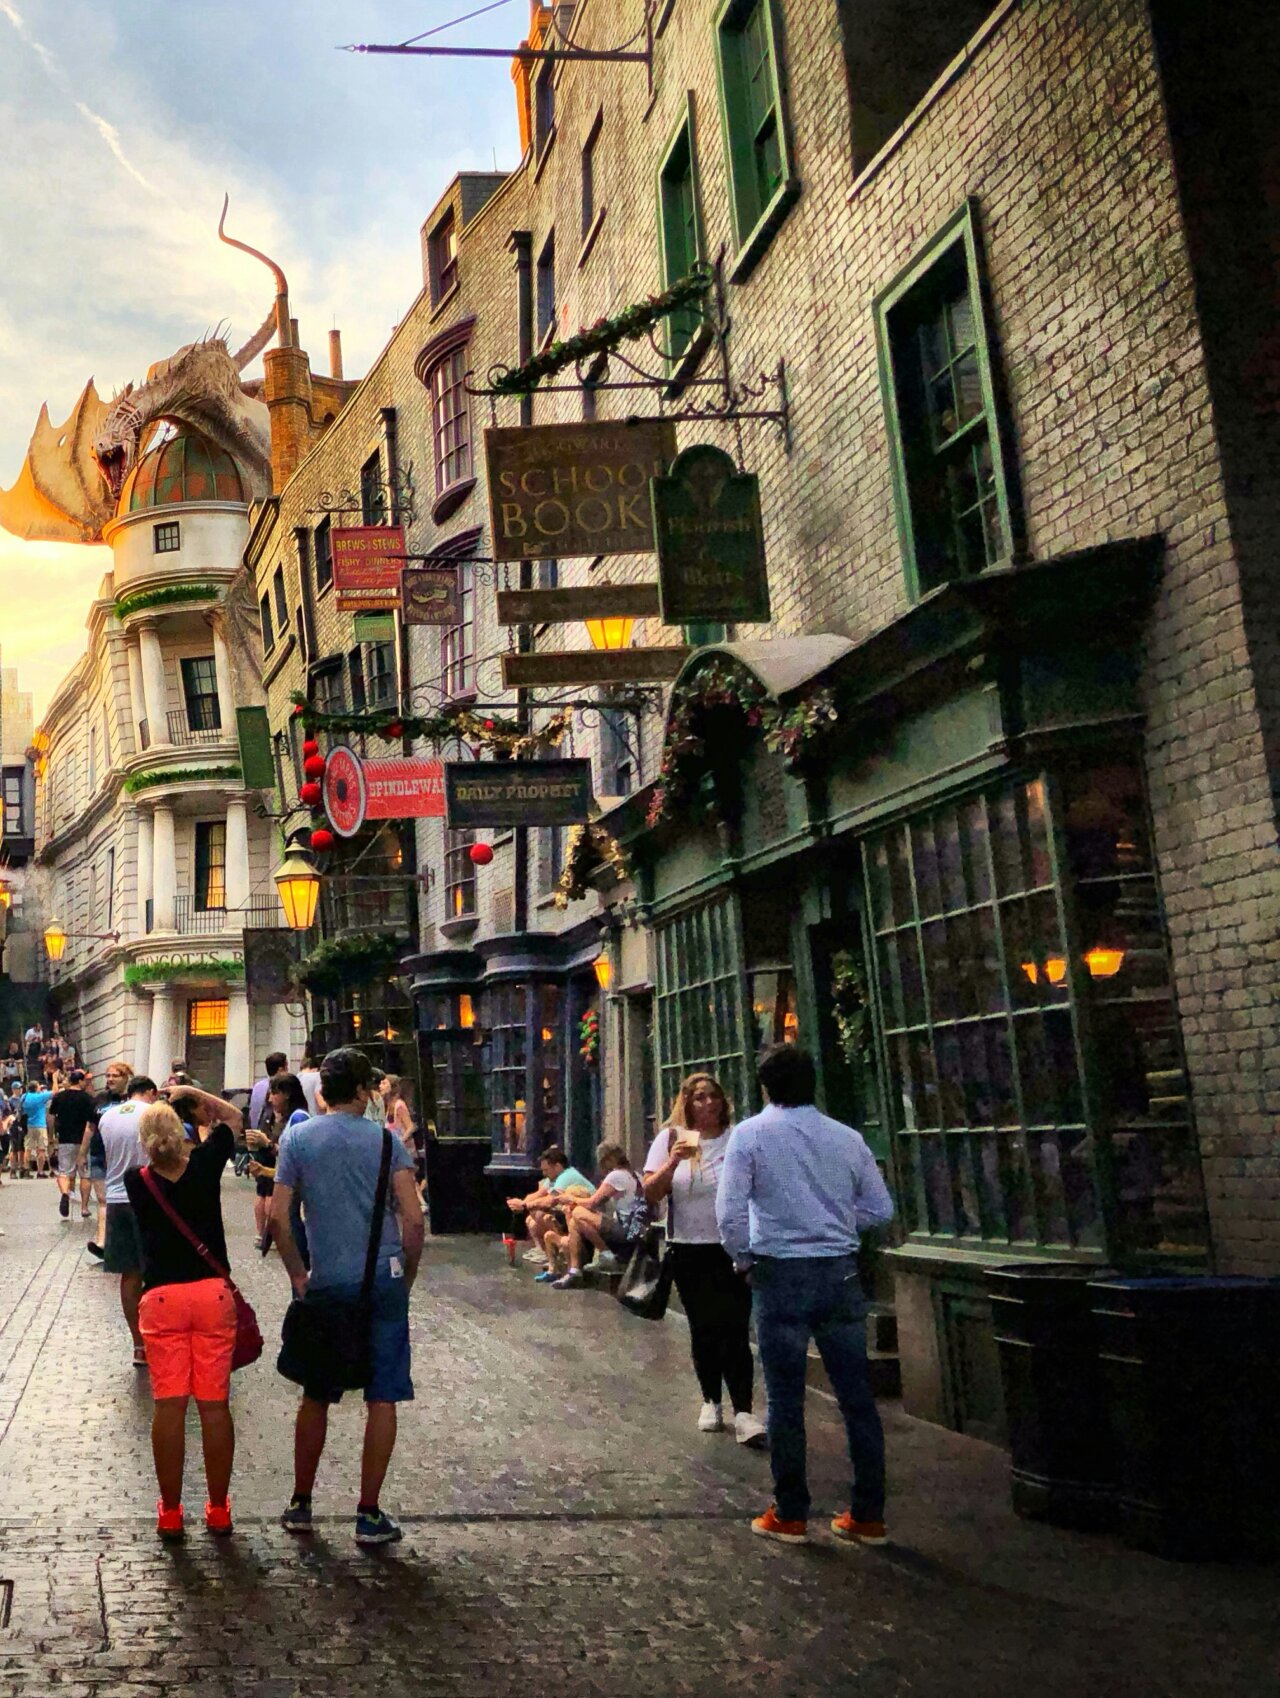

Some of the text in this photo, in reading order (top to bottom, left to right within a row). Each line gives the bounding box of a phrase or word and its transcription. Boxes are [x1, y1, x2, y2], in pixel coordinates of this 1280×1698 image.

[336, 539, 366, 552] BREWS
[372, 538, 401, 551] STEWS
[337, 558, 360, 567] FISHY
[369, 778, 445, 798] SPINDLEWA
[457, 783, 581, 801] DAILY PROPHET
